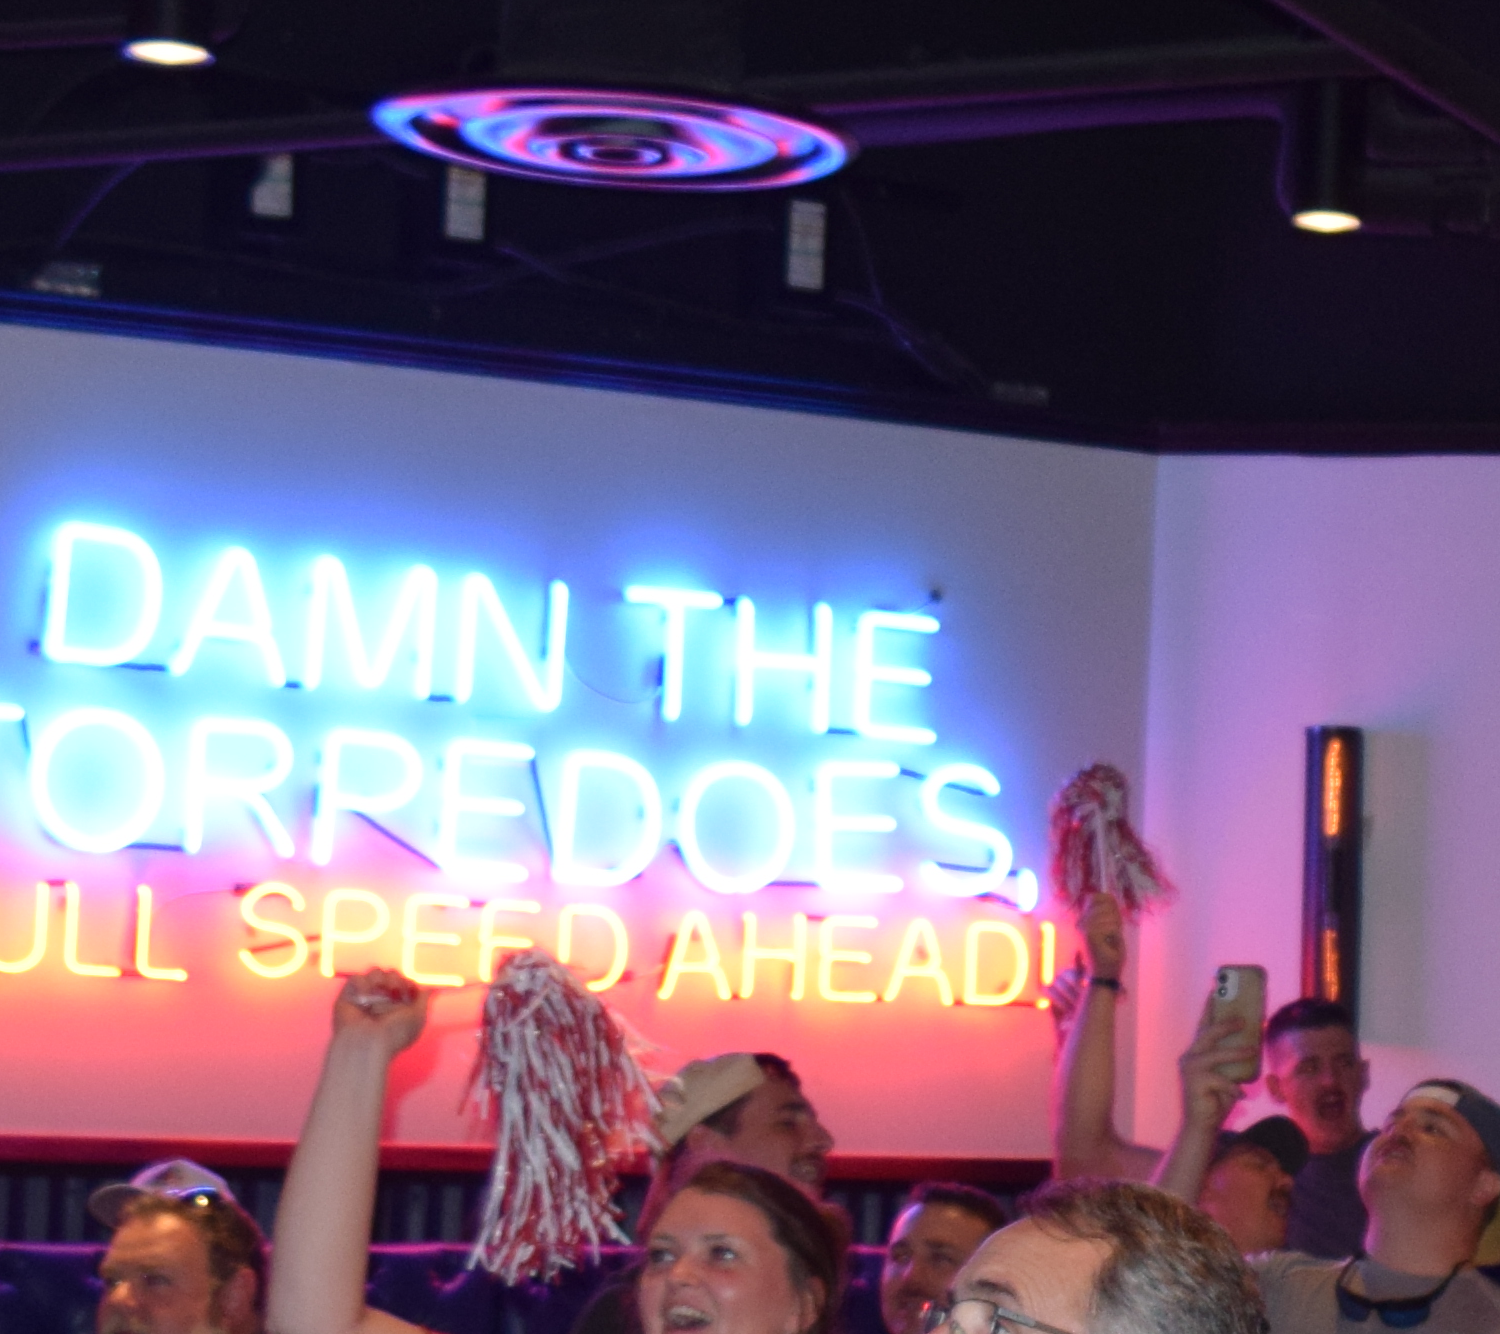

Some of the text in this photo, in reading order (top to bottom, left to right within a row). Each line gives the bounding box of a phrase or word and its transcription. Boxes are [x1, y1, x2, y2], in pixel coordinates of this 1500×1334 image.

[40, 520, 942, 746] DAMN THE
[656, 910, 1056, 1010] AHEAD!
